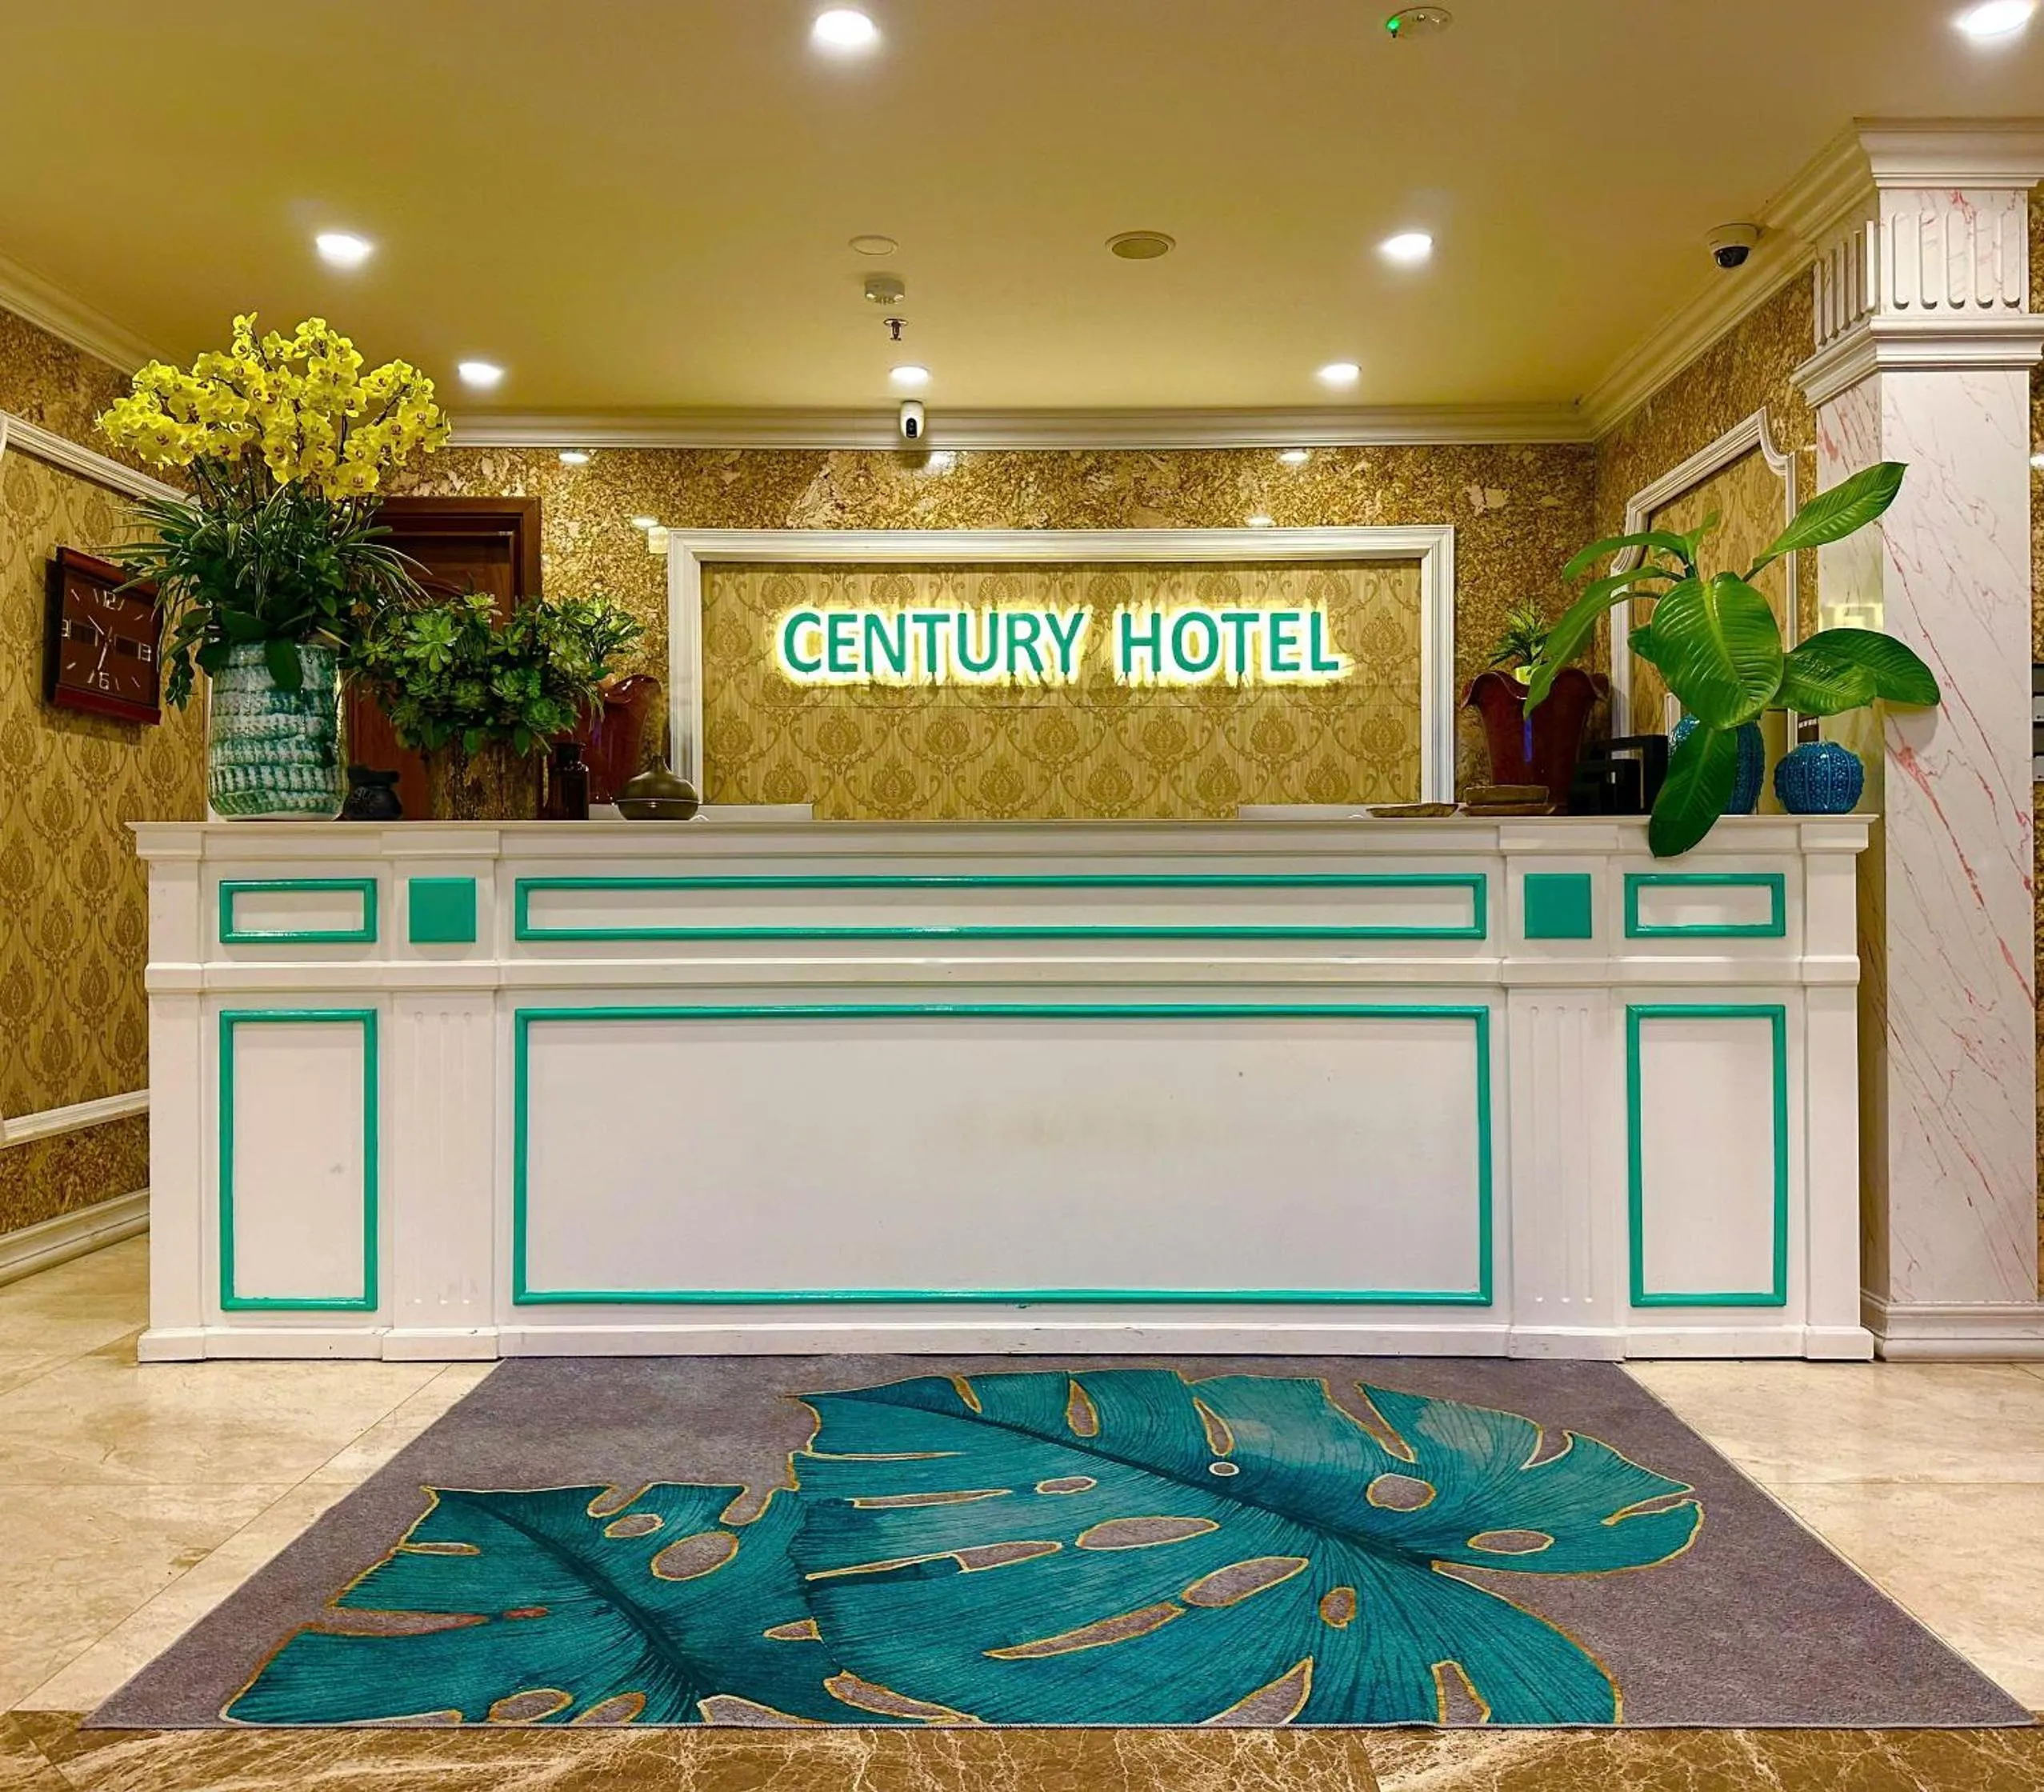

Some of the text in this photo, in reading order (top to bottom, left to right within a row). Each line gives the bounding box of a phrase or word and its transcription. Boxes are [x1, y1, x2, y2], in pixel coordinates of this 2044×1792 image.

[103, 590, 117, 610] 12
[783, 612, 1340, 673] CENTURY HOTEL
[98, 671, 110, 690] 6
